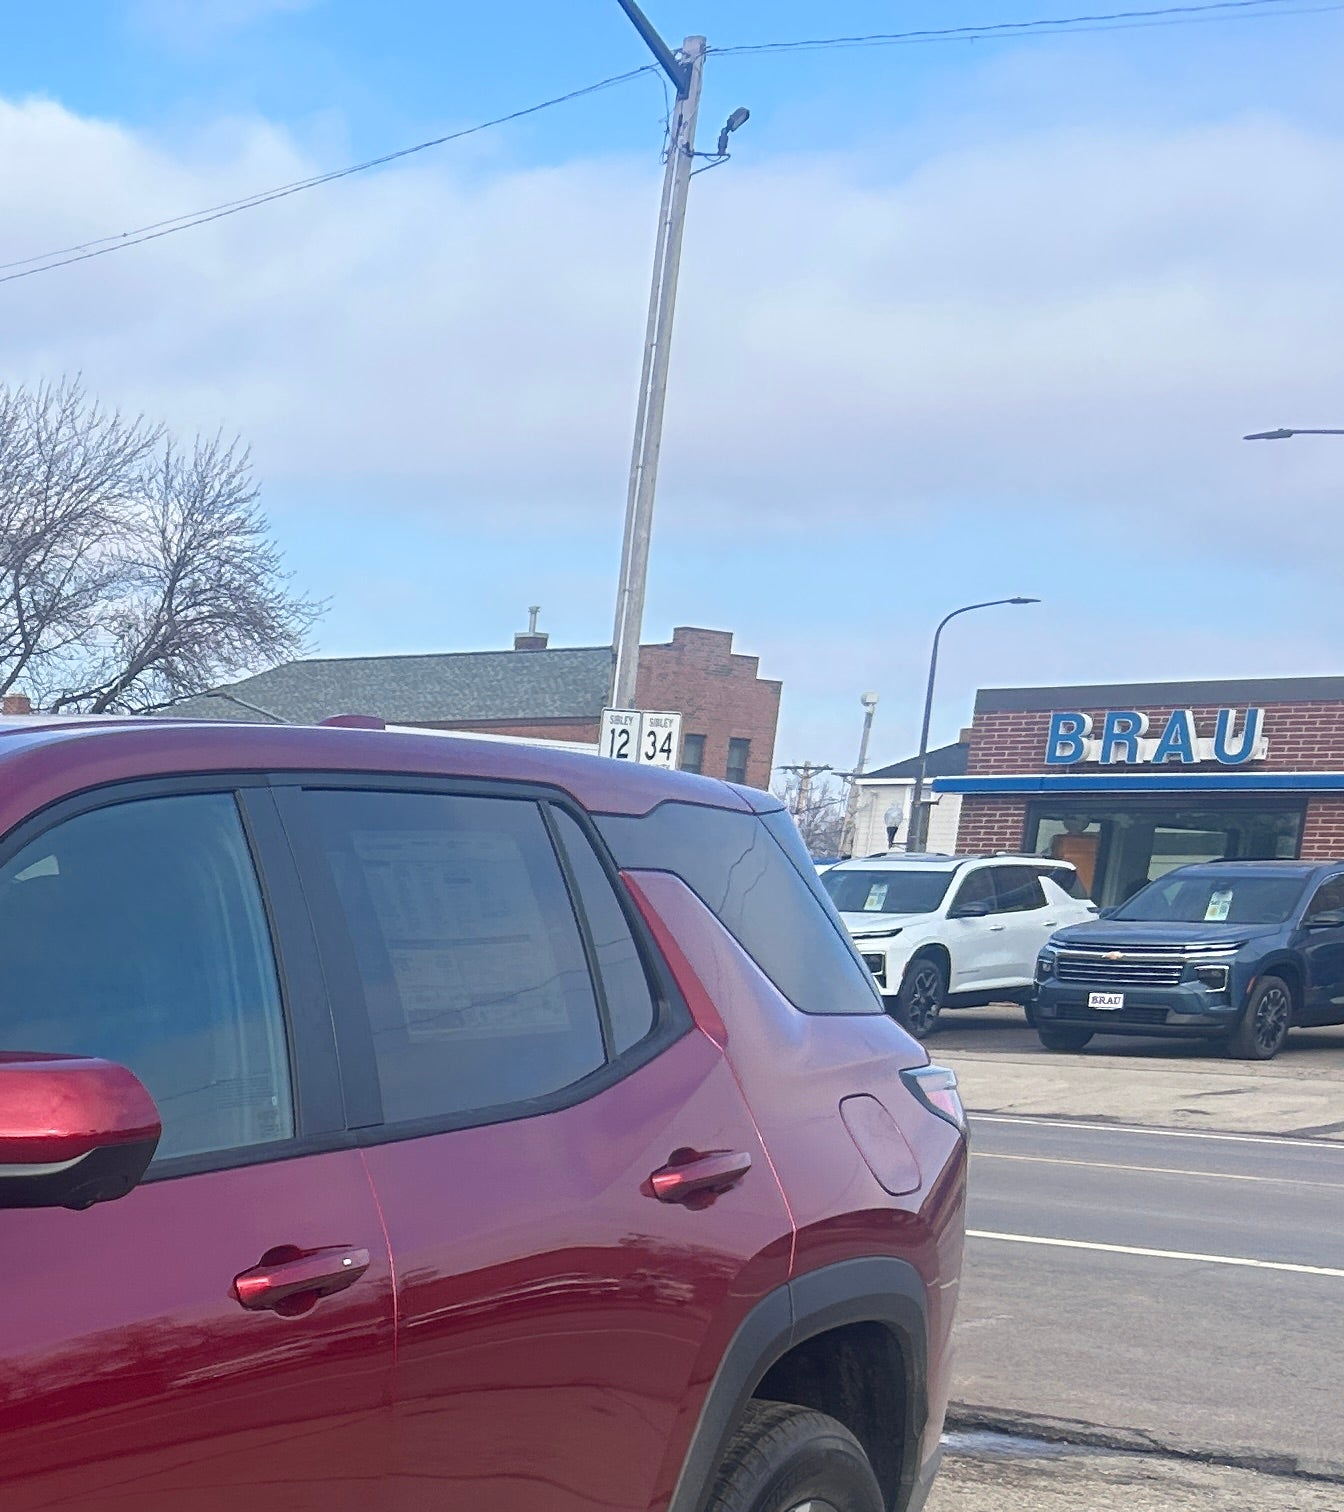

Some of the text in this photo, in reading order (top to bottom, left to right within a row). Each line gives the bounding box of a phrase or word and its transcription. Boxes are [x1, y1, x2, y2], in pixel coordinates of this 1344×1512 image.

[610, 728, 630, 759] 12
[644, 730, 673, 761] 34
[1044, 707, 1266, 765] BRAU
[1091, 996, 1121, 1005] BRAU
